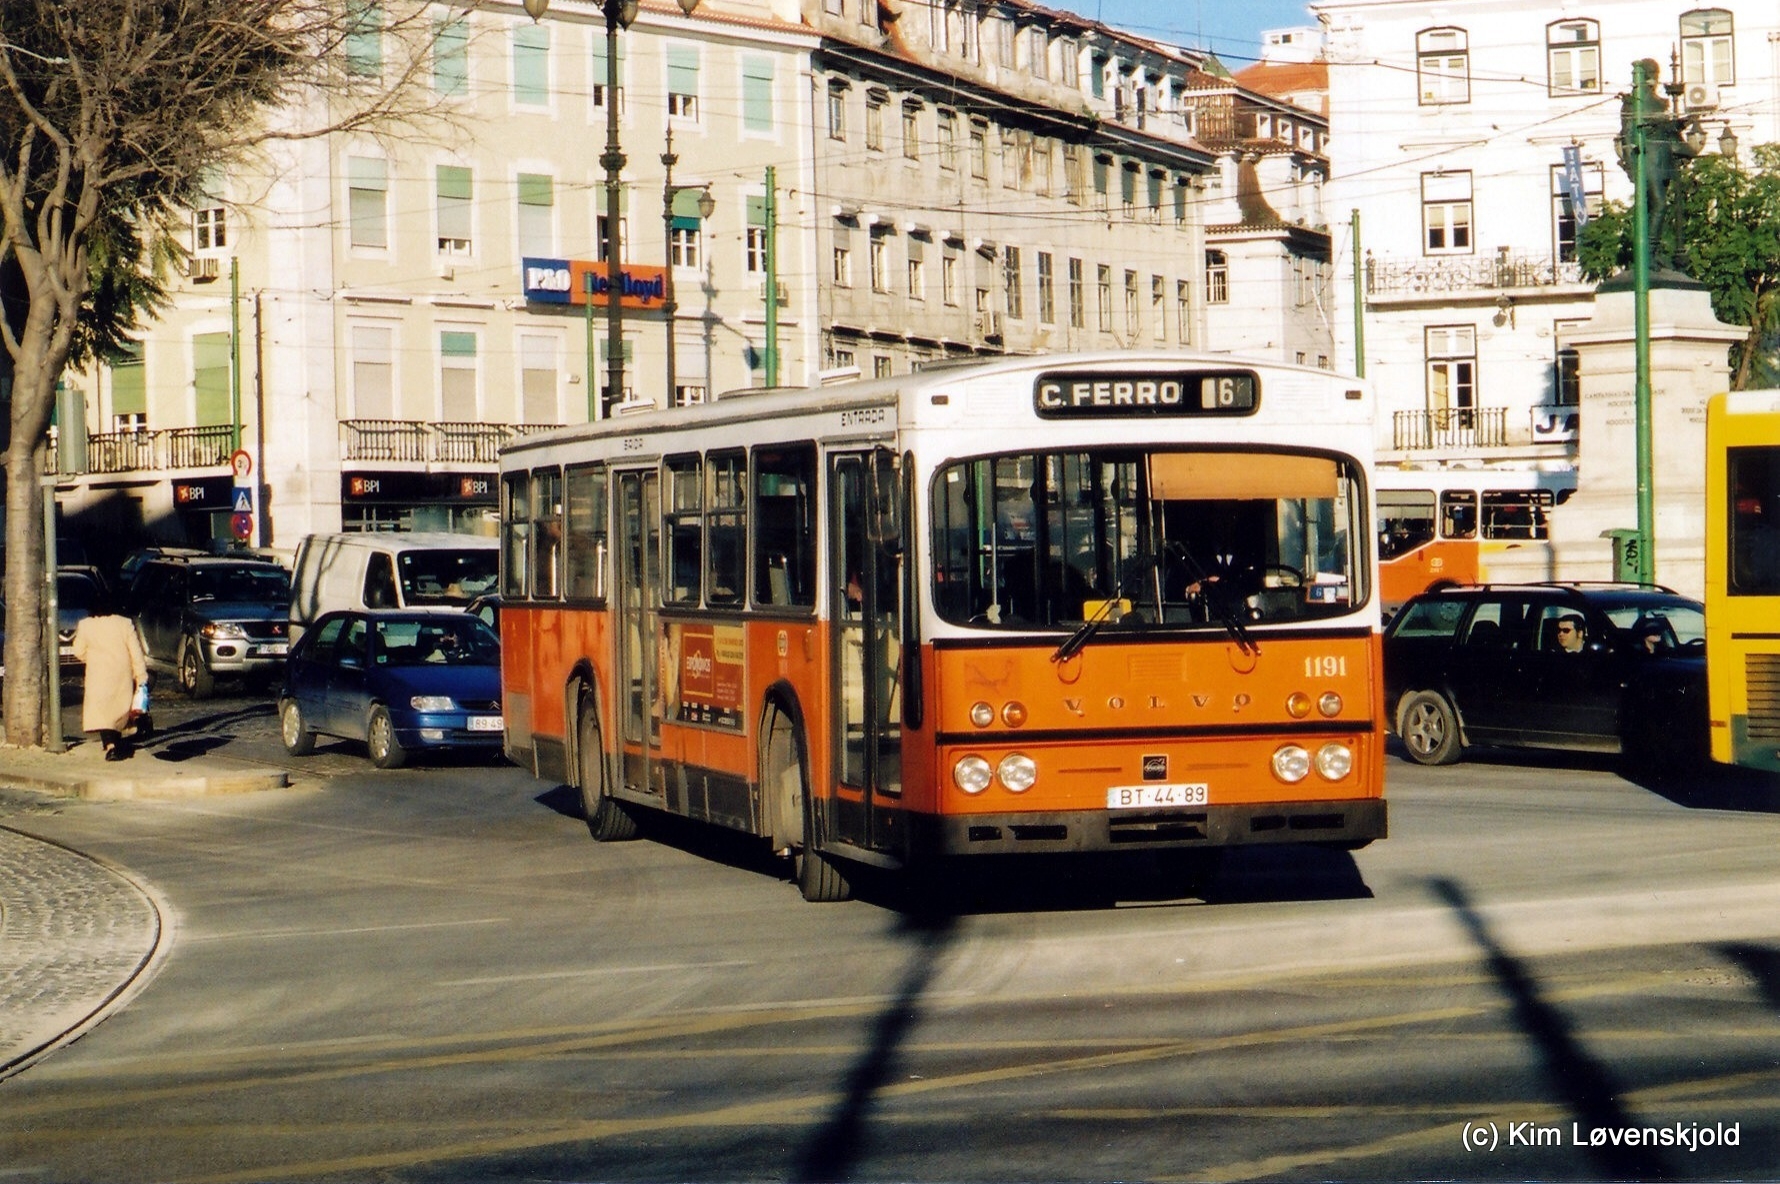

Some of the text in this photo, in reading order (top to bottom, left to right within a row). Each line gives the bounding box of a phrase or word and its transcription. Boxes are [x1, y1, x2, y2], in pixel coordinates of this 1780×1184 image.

[528, 267, 572, 291] P&O
[1073, 381, 1181, 407] FERRO
[842, 409, 884, 426] ENTRADA
[189, 486, 205, 500] BPI
[364, 479, 380, 493] BPI
[472, 480, 488, 494] BPI
[1304, 656, 1347, 677] 1191
[1063, 693, 1252, 713] VOLVO
